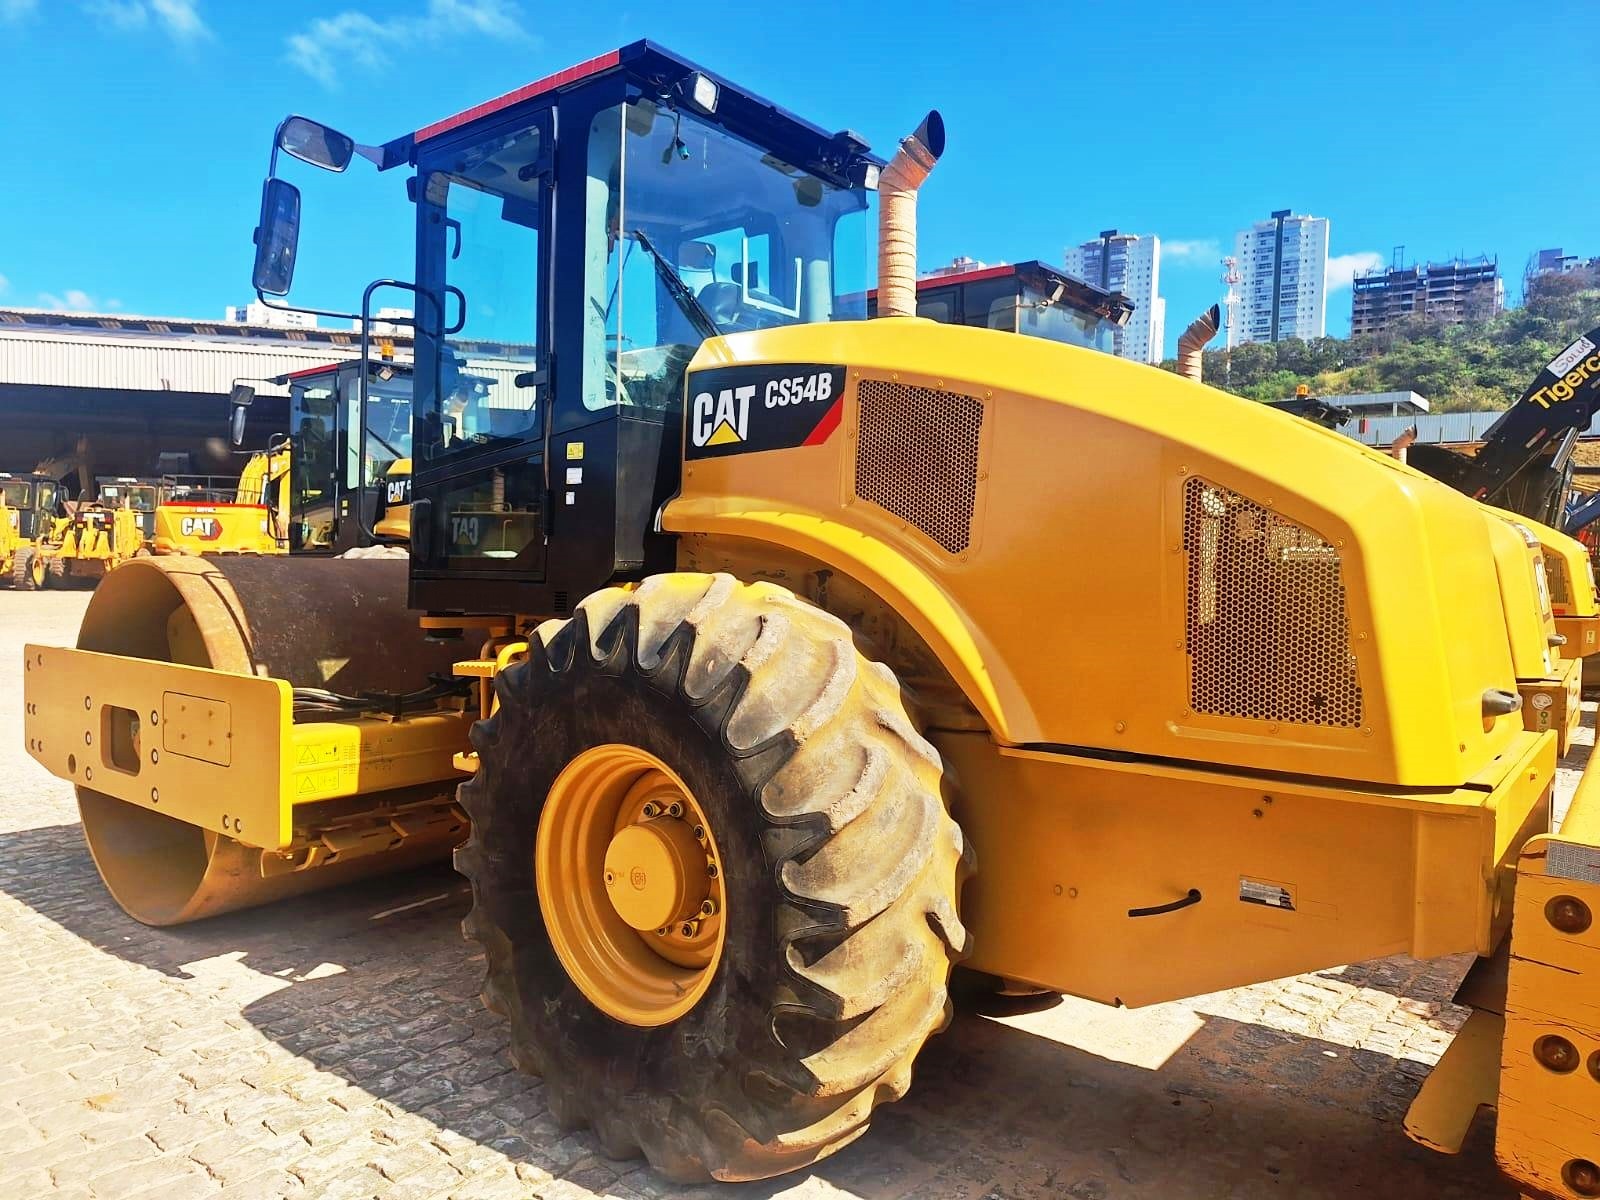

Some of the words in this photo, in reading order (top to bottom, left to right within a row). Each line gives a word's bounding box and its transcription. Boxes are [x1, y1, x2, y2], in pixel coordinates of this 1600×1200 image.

[1528, 352, 1600, 409] Tigerc
[693, 385, 756, 447] CAT
[765, 373, 832, 408] CS54B
[388, 480, 405, 503] CAT
[181, 517, 213, 536] CAT
